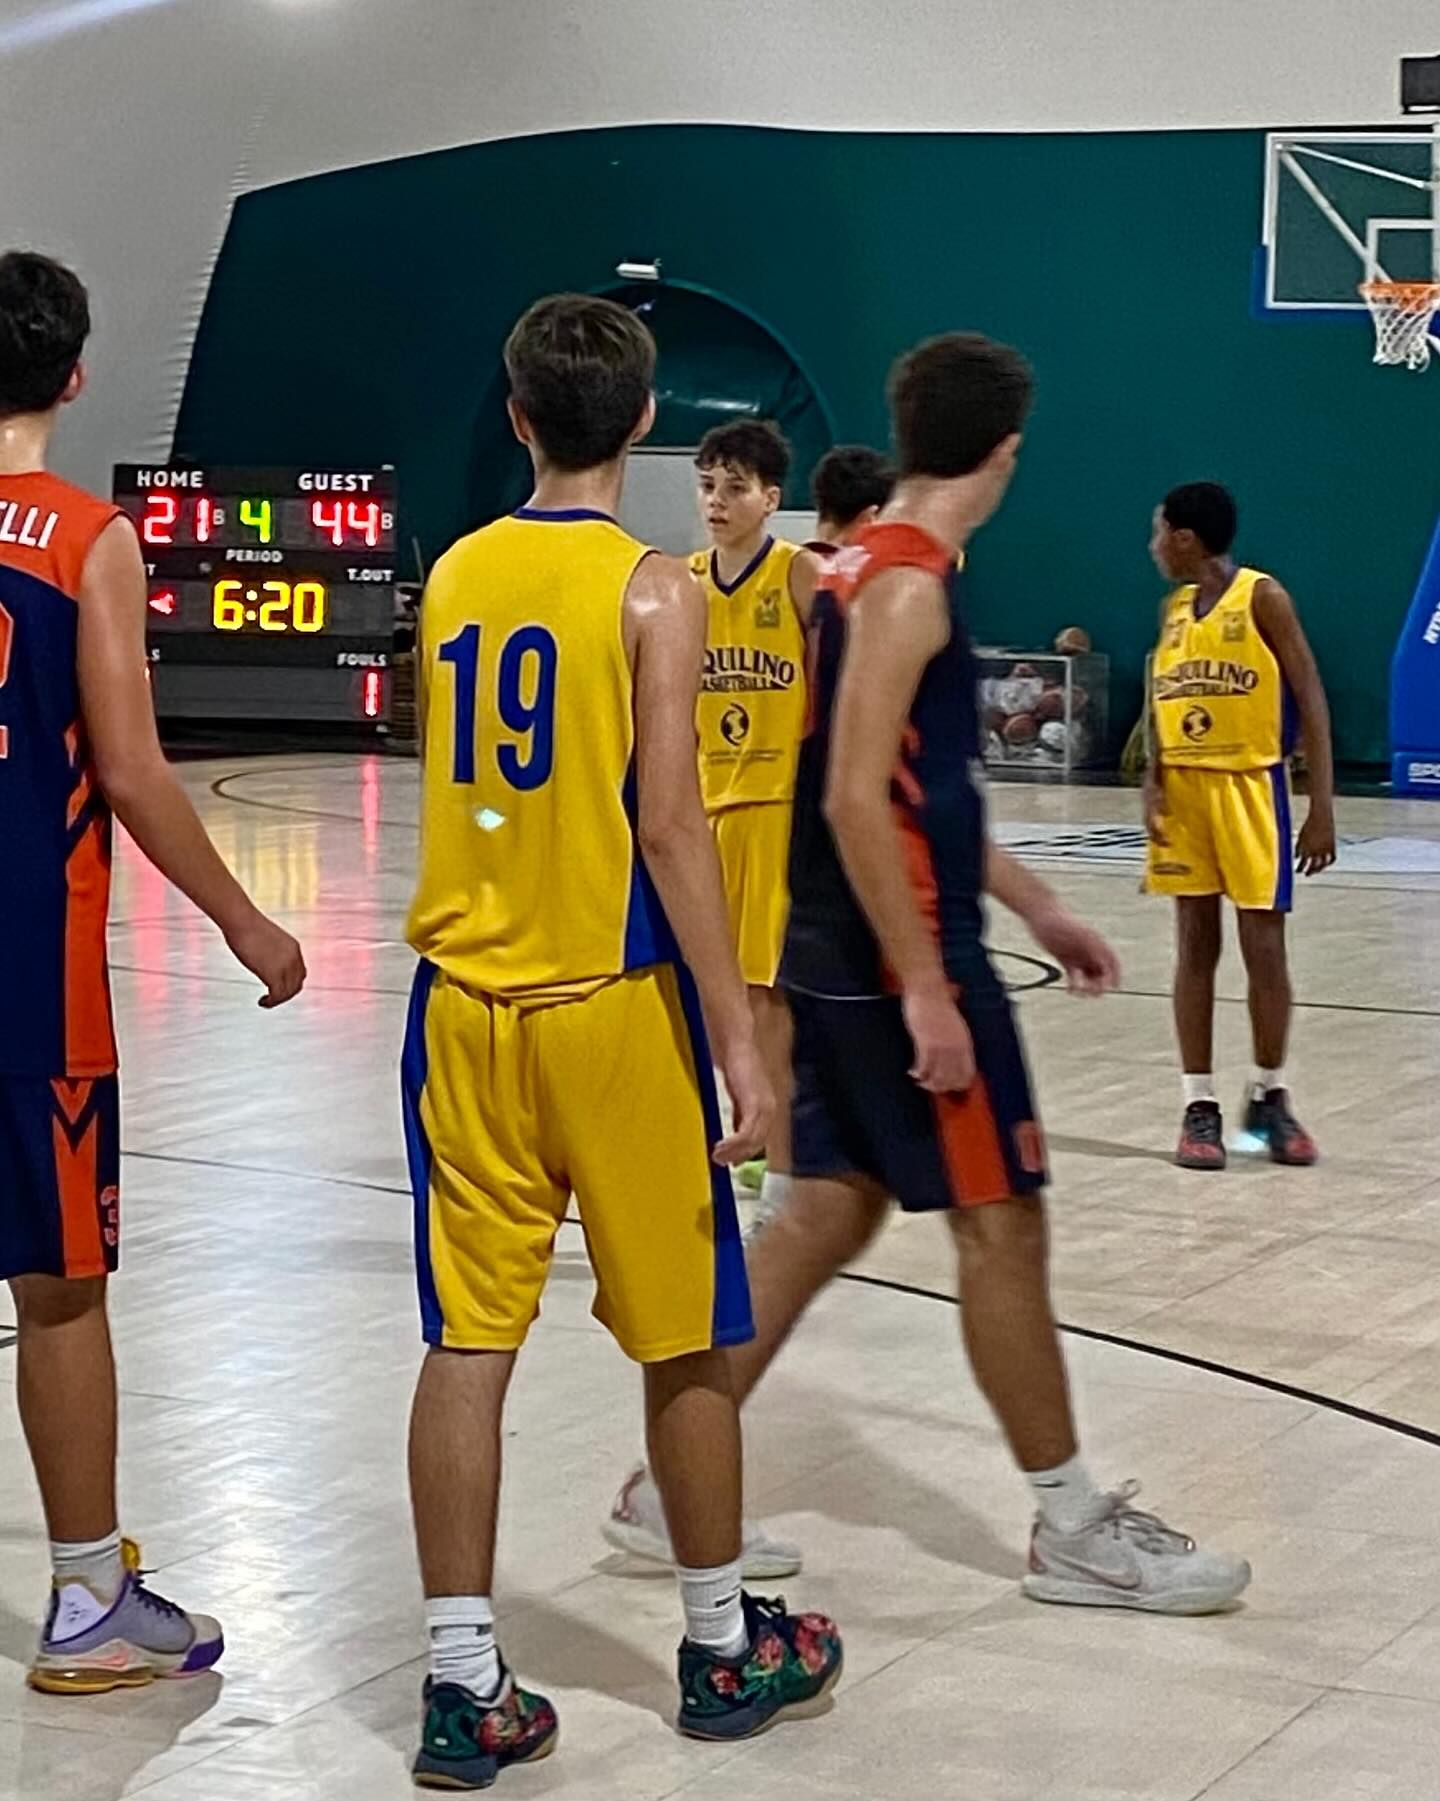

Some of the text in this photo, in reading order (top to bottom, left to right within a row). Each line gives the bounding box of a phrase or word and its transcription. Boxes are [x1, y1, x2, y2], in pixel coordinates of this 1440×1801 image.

[137, 471, 204, 488] HOME
[298, 474, 374, 492] GUEST
[144, 496, 210, 544] 21
[239, 500, 272, 544] 4
[312, 500, 380, 546] 44
[225, 550, 284, 563] PERIOD
[213, 579, 325, 632] 6:20
[336, 653, 387, 667] FOULS
[364, 672, 379, 716] 1
[438, 624, 558, 790] 19
